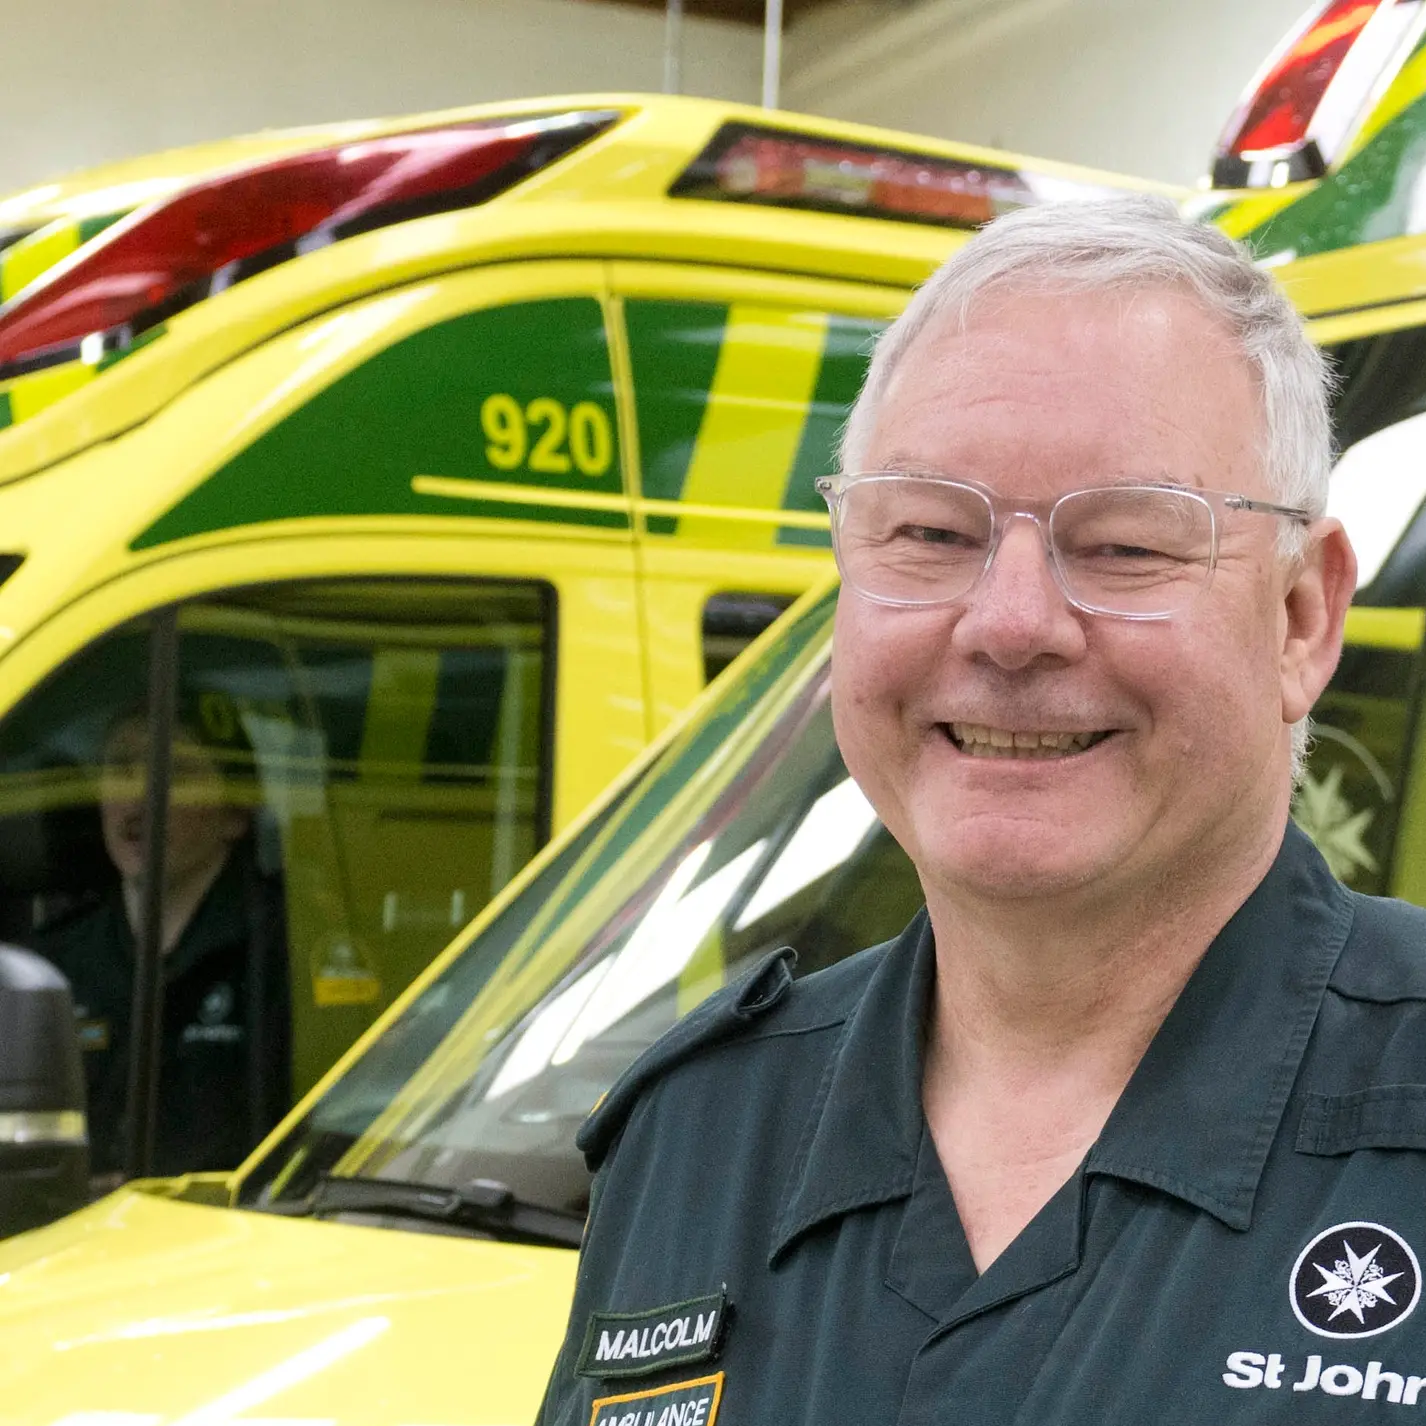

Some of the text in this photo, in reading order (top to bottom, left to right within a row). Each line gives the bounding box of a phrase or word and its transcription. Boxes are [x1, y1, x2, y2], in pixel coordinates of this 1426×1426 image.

[481, 393, 613, 476] 920
[595, 1311, 716, 1361] MALCOLM
[1222, 1351, 1285, 1389] St
